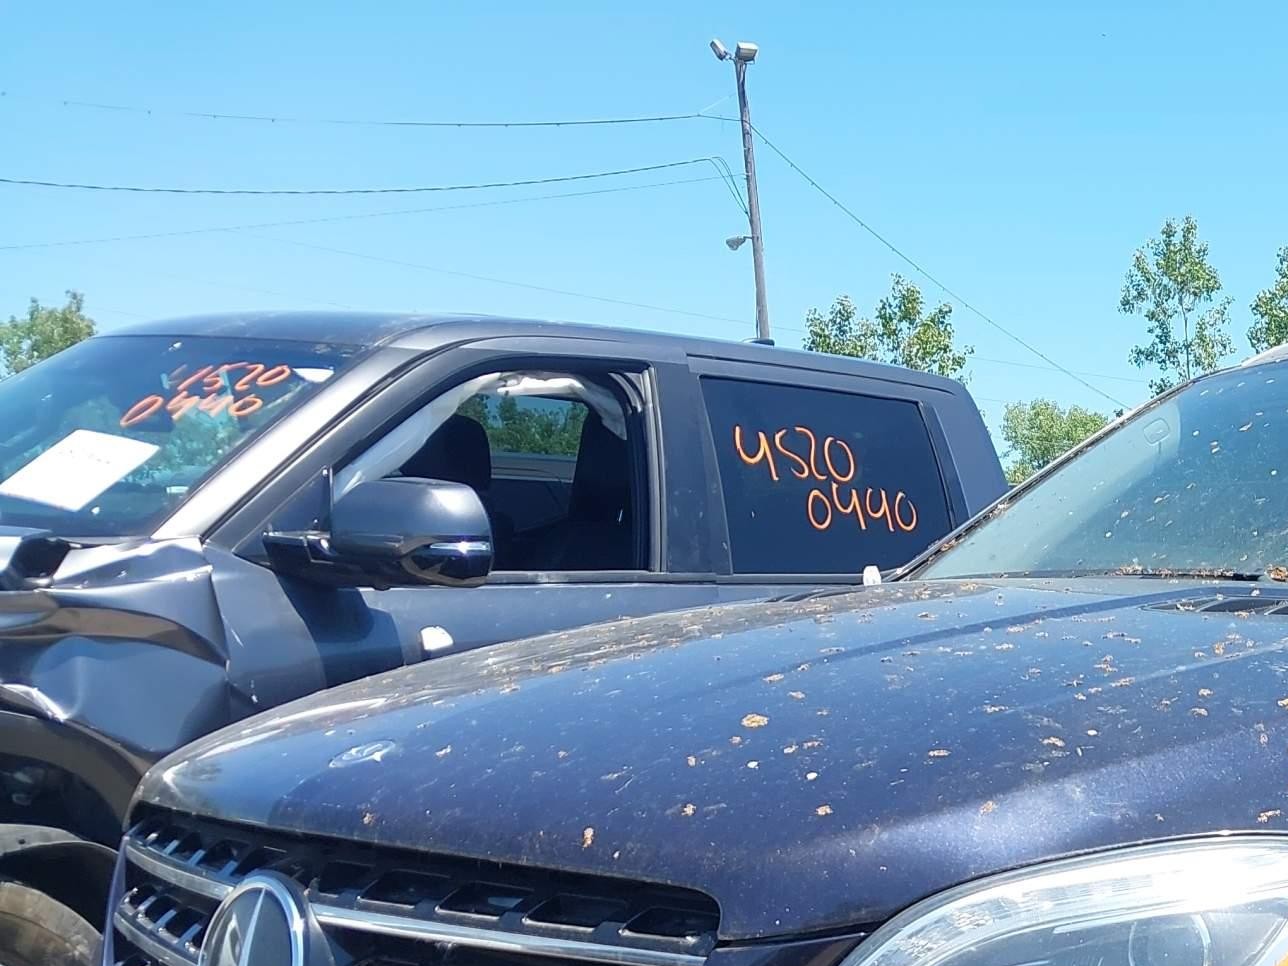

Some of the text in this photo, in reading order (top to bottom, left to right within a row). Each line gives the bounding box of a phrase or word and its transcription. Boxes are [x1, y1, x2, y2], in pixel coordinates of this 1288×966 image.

[119, 390, 264, 427] 0440
[734, 425, 855, 482] 4520
[807, 481, 918, 532] 0440
